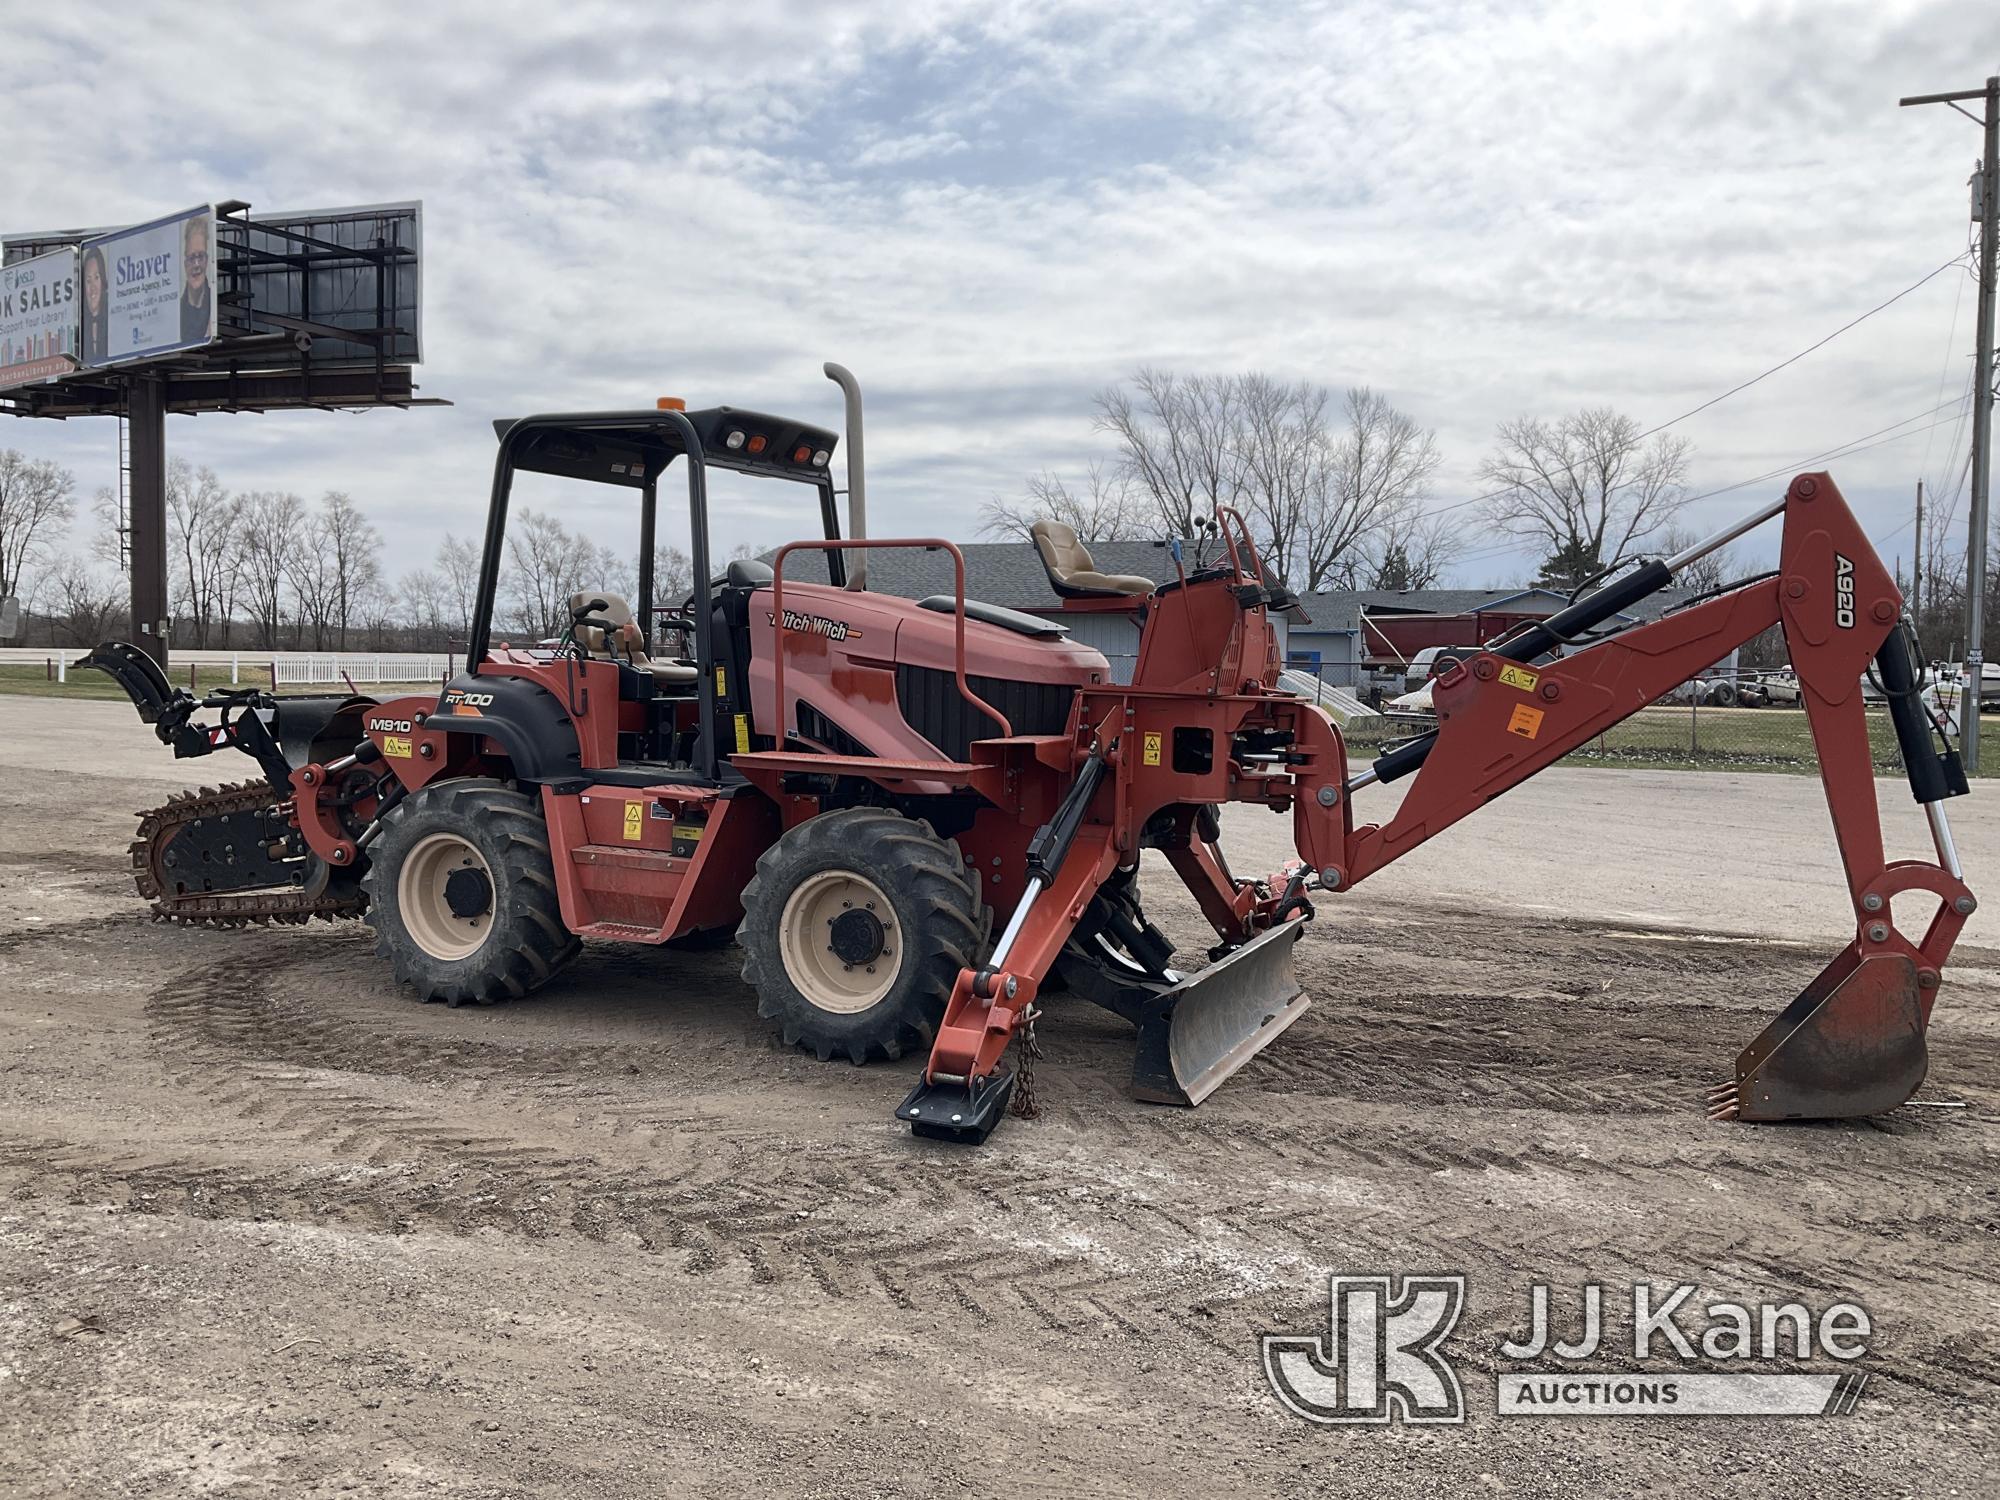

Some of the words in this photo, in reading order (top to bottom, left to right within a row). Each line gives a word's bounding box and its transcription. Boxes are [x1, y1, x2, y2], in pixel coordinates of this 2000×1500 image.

[116, 252, 171, 286] Shaver
[0, 294, 13, 319] K
[20, 277, 73, 314] SALES
[116, 284, 140, 298] Insurance
[0, 318, 24, 336] Support
[25, 316, 40, 329] Your
[1836, 553, 1854, 628] A920
[813, 616, 847, 640] Witch
[369, 718, 412, 733] M910
